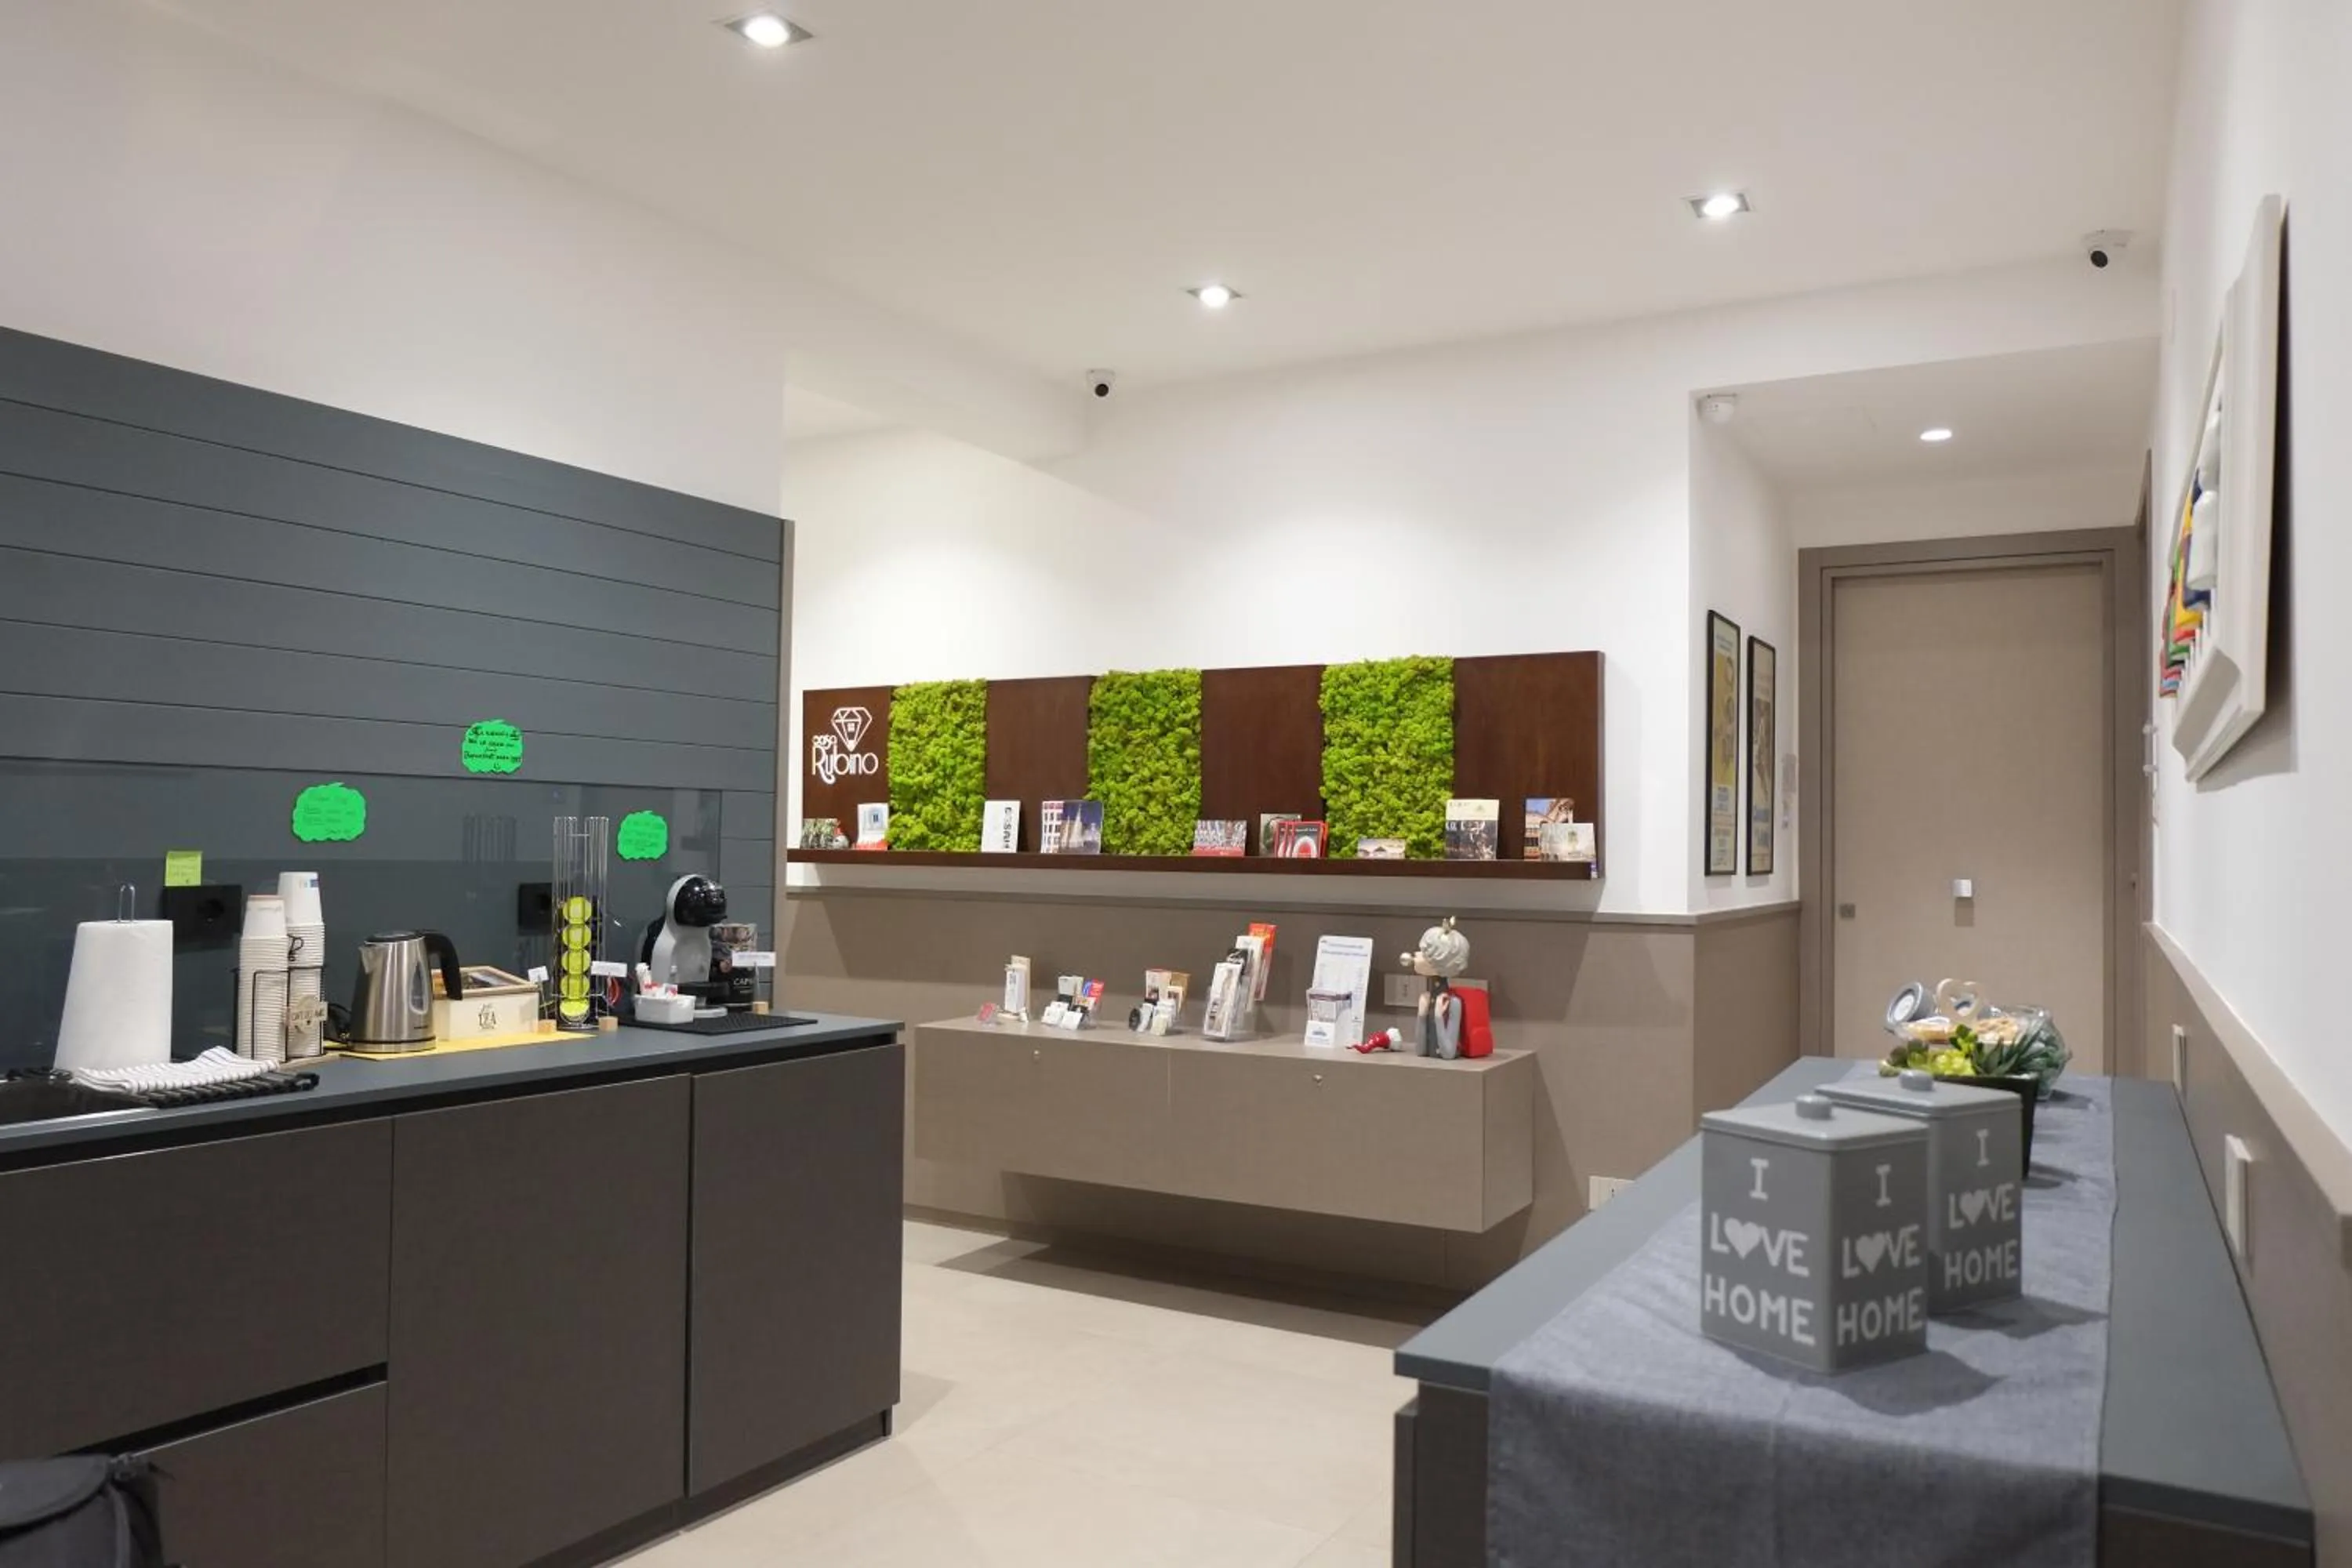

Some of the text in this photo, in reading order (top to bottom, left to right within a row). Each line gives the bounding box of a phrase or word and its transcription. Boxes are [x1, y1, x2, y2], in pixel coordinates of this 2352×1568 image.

[811, 744, 879, 784] Rubino
[1976, 1128, 1991, 1167] I
[1749, 1157, 1769, 1201] I
[1875, 1163, 1892, 1207] I
[1944, 1238, 2019, 1291] HOME
[1704, 1272, 1817, 1347] HOME
[1837, 1285, 1924, 1347] HOME
